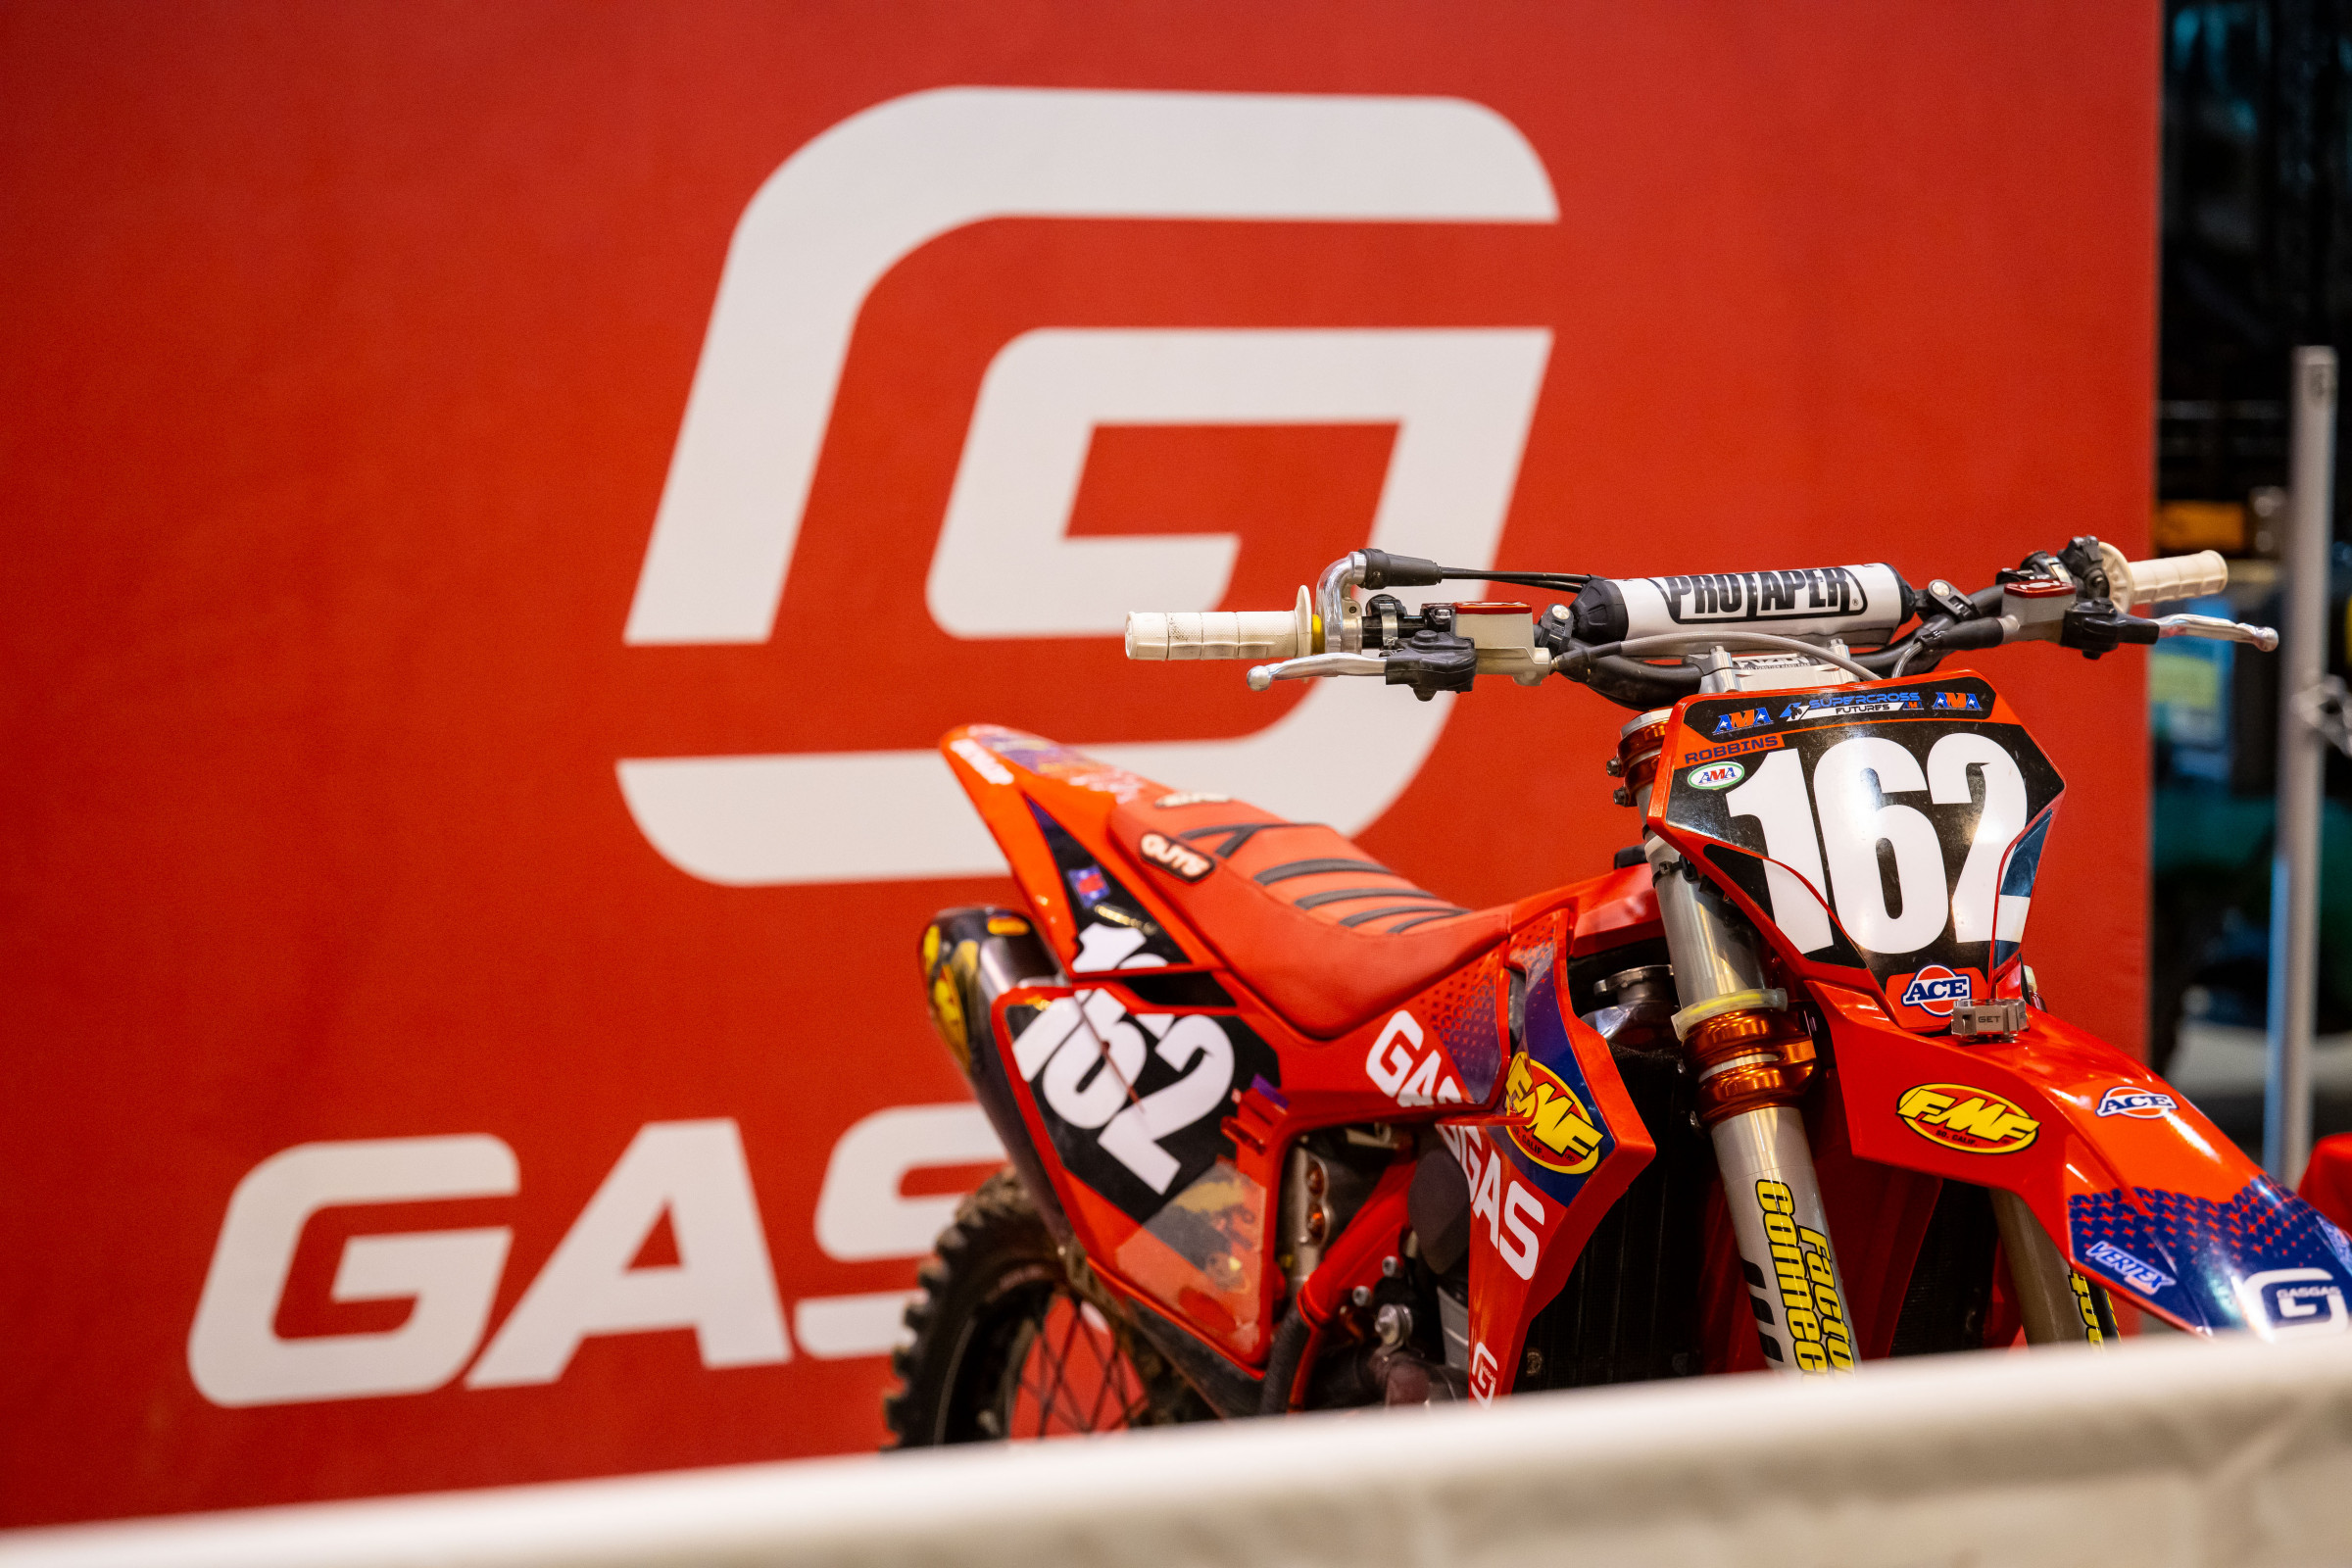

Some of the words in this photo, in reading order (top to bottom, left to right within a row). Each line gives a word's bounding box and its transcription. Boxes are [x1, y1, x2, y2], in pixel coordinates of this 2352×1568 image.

[1665, 565, 1852, 620] PROTAPER
[1808, 691, 1922, 710] SUPERCROSS
[1835, 703, 1891, 715] FUTURES
[1932, 691, 1984, 710] AMA
[1712, 707, 1774, 735] AMA
[1684, 735, 1779, 764] ROBBINS
[1697, 766, 1739, 785] AMA
[1725, 731, 2032, 956] 162
[1905, 977, 1969, 1003] ACE
[1505, 1054, 1605, 1160] FMF
[1895, 1088, 2042, 1144] FMF
[2101, 1095, 2174, 1113] ACE
